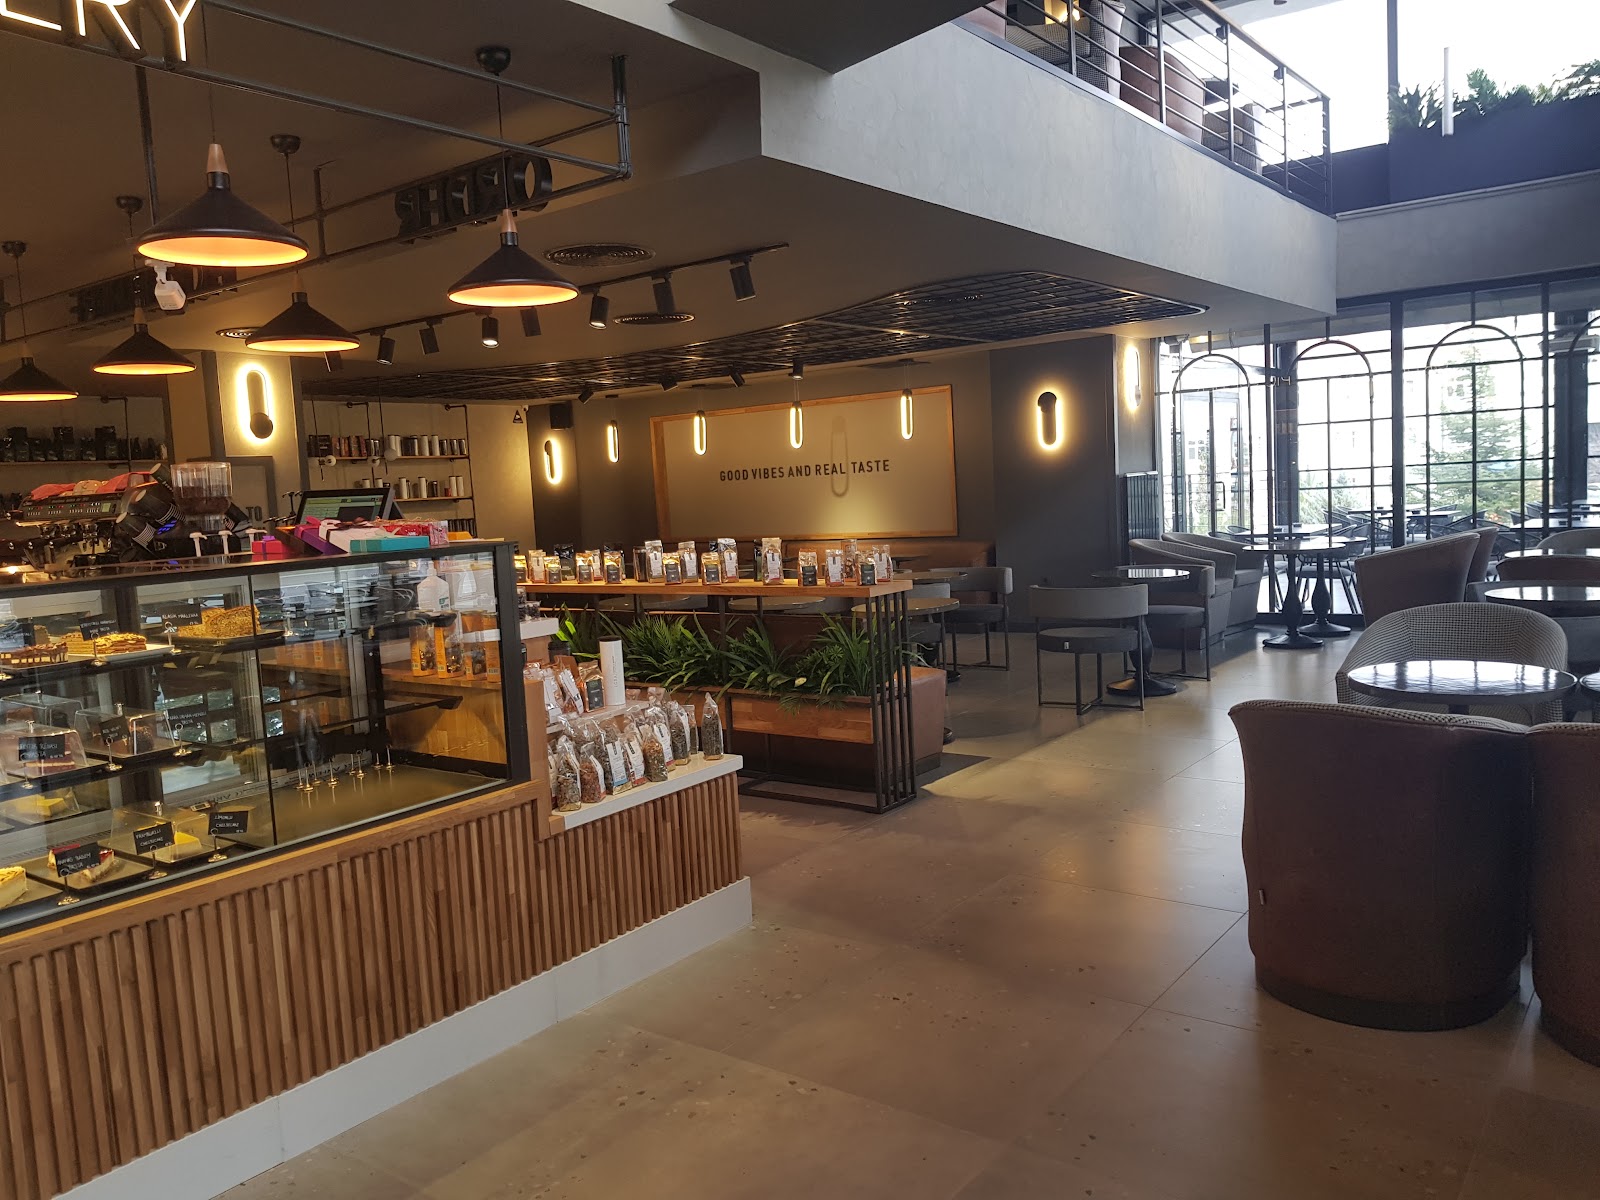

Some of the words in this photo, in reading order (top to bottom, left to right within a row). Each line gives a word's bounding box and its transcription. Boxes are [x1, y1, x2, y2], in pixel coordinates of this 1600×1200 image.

[719, 469, 749, 482] GOOD
[751, 466, 785, 480] VIBES
[787, 464, 811, 478] AND
[815, 462, 846, 476] REAL
[851, 459, 890, 474] TASTE
